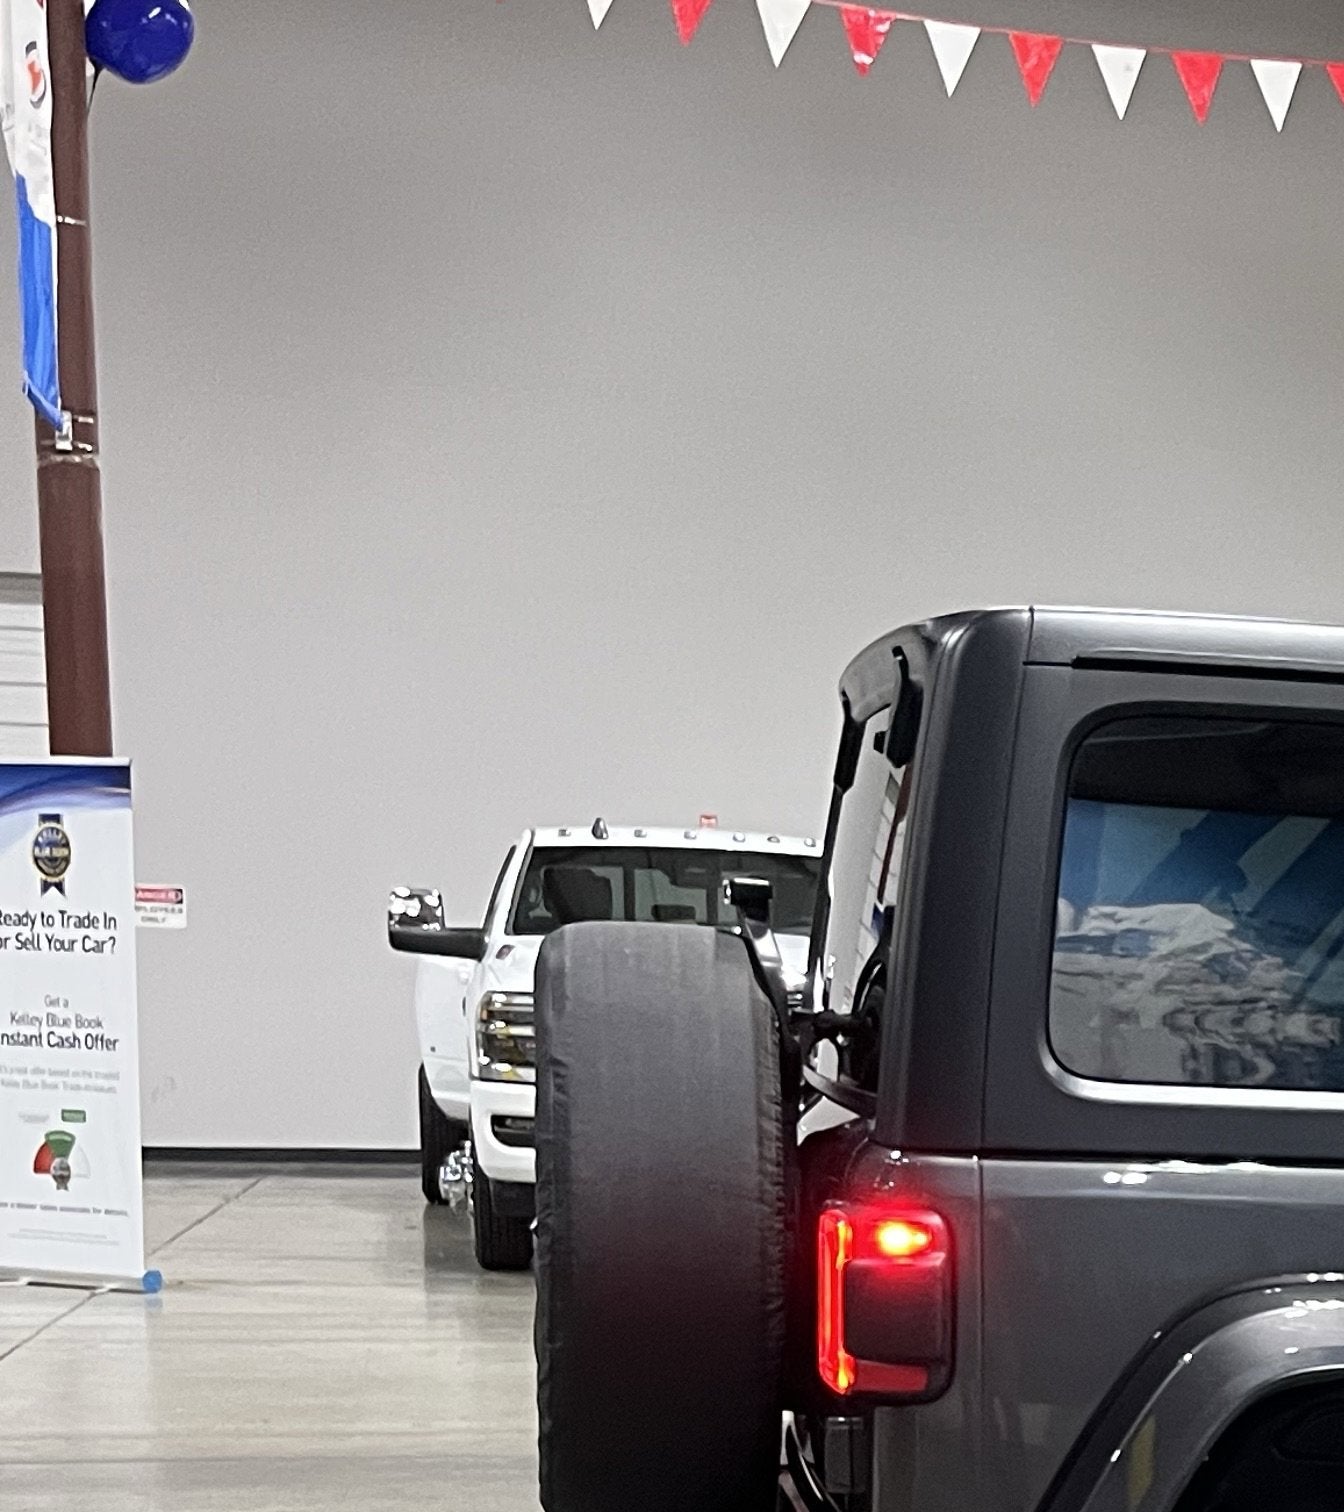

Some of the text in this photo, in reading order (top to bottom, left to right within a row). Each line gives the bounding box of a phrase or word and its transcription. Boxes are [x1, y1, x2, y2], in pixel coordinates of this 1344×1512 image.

[41, 911, 55, 928] to
[58, 910, 100, 930] Trade
[104, 911, 117, 930] In
[15, 932, 42, 951] Sell
[45, 933, 78, 952] Your
[82, 935, 116, 954] Car?
[44, 994, 69, 1008] Get a
[10, 1011, 103, 1031] Kelley Blue Book
[0, 1031, 119, 1051] nstant Cash Offer
